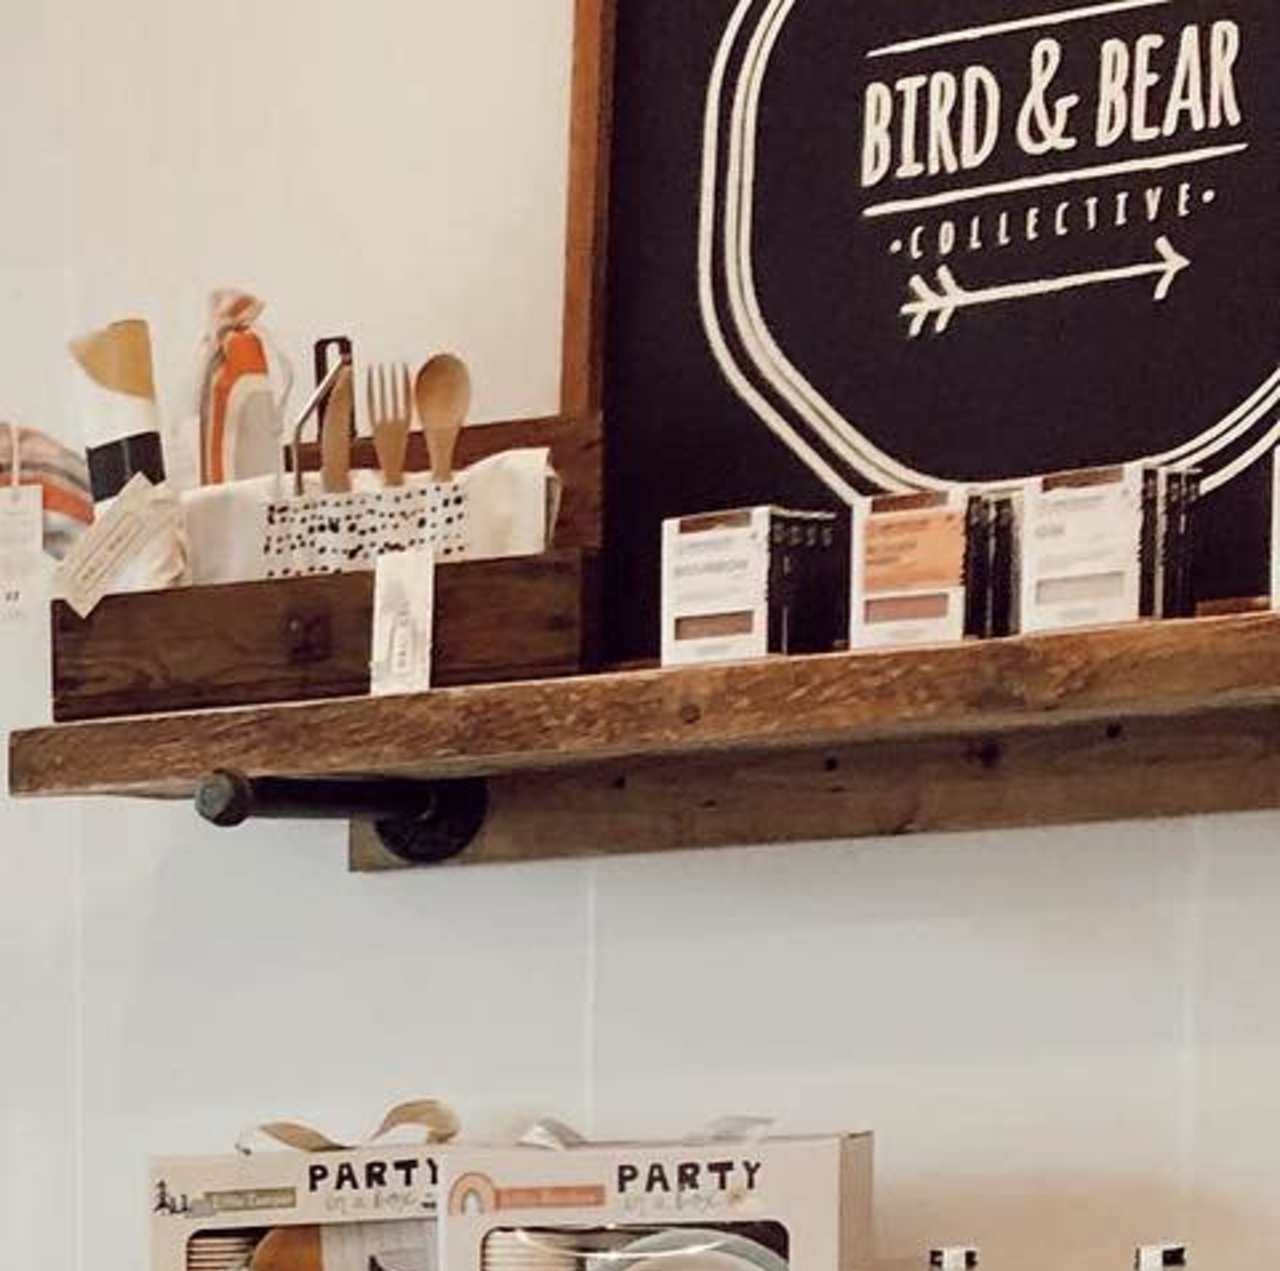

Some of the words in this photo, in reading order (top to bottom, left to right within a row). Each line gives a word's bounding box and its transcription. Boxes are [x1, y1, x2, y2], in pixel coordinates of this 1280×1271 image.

[861, 64, 1001, 188] BIRD
[1015, 37, 1080, 156] &
[1095, 19, 1242, 148] BEAR
[908, 181, 1192, 261] COLLECTIVE
[308, 1157, 438, 1193] PARTY
[617, 1160, 762, 1194] PARTY
